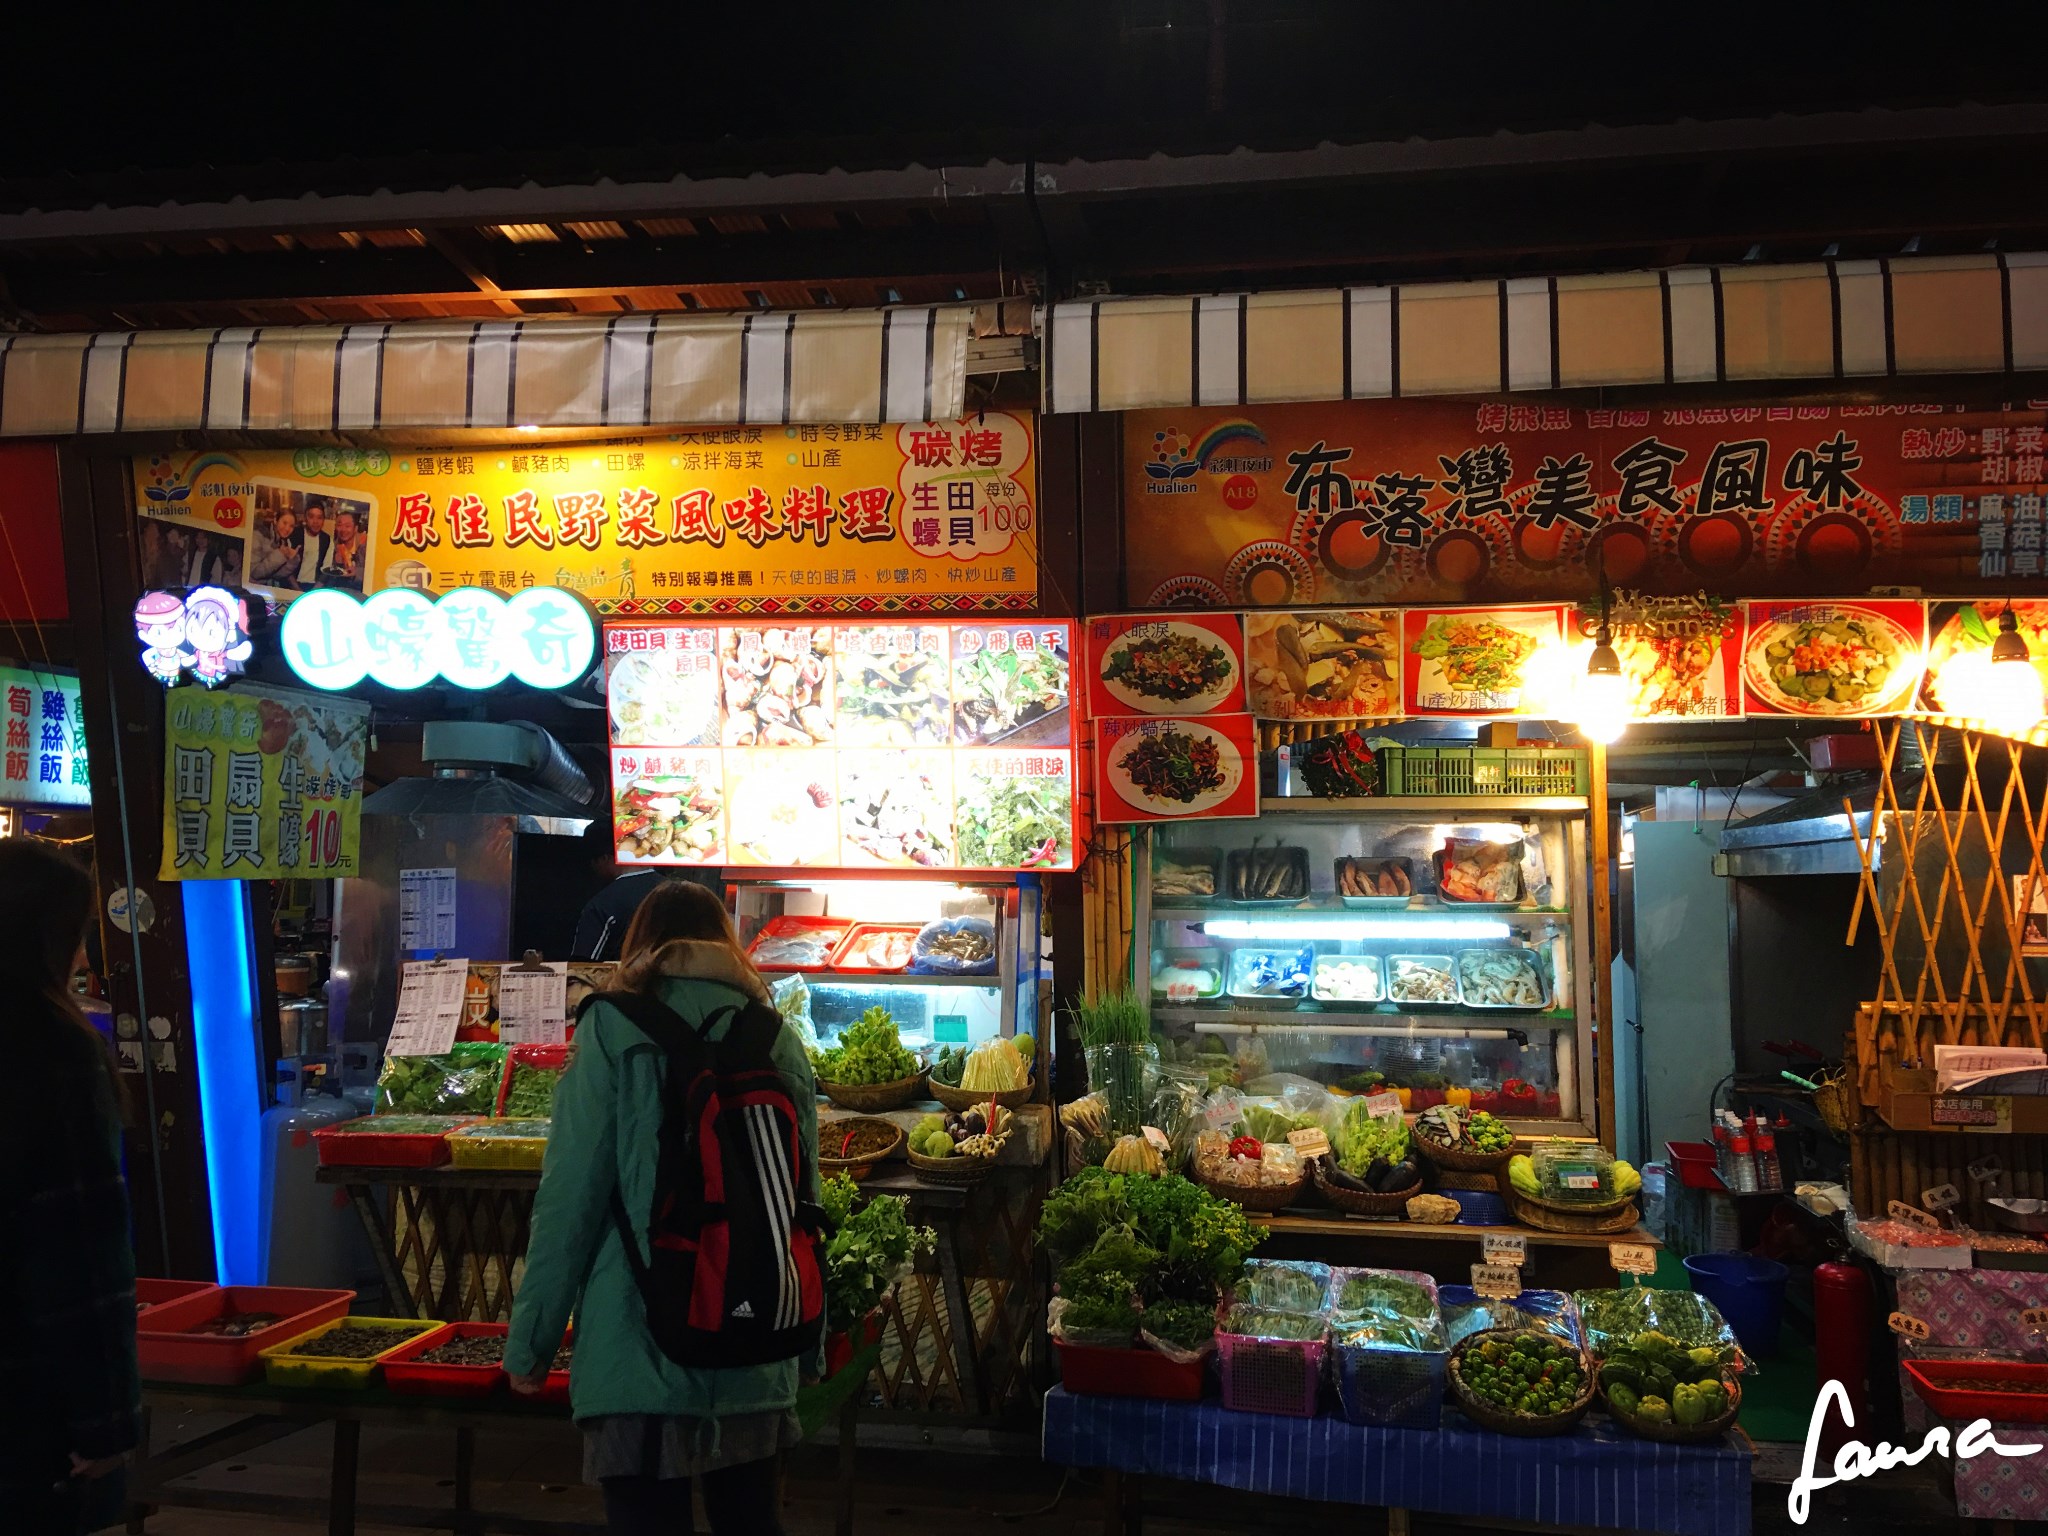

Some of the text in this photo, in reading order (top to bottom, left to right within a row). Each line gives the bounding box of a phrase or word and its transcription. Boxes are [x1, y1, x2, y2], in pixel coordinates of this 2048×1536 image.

[801, 423, 883, 443] 時令野菜
[801, 448, 842, 469] 山產
[909, 429, 1003, 468] 碳烤
[416, 457, 475, 476] 鹽烤蝦
[511, 455, 570, 474] 鹹豬肉
[606, 453, 645, 472] 田螺
[682, 451, 764, 471] 涼拌海菜
[986, 482, 1017, 497] 每份
[1146, 481, 1198, 495] Hualien
[1225, 487, 1257, 500] A18
[1284, 430, 1863, 548] 布落灣美食風味
[216, 508, 241, 520] A19
[947, 482, 977, 547] 田貝
[1979, 493, 2048, 521] 麻油
[390, 485, 897, 551] 原住民野菜風味料理
[977, 503, 1034, 533] 100
[1978, 522, 2048, 549] 香菇
[1978, 550, 2048, 578] 仙草
[439, 570, 536, 589] 三立電視台
[296, 601, 578, 674] 山蠔驚奇
[1094, 621, 1170, 639] 情人眼淚
[610, 631, 667, 651] 烤田貝
[676, 655, 712, 674] 扇貝
[5, 685, 32, 782] 筍絲飯
[39, 690, 65, 784] 雞絲飯
[1103, 720, 1178, 738] 辣炒蝸牛
[174, 744, 216, 869] 田貝
[222, 750, 264, 869] 扇貝
